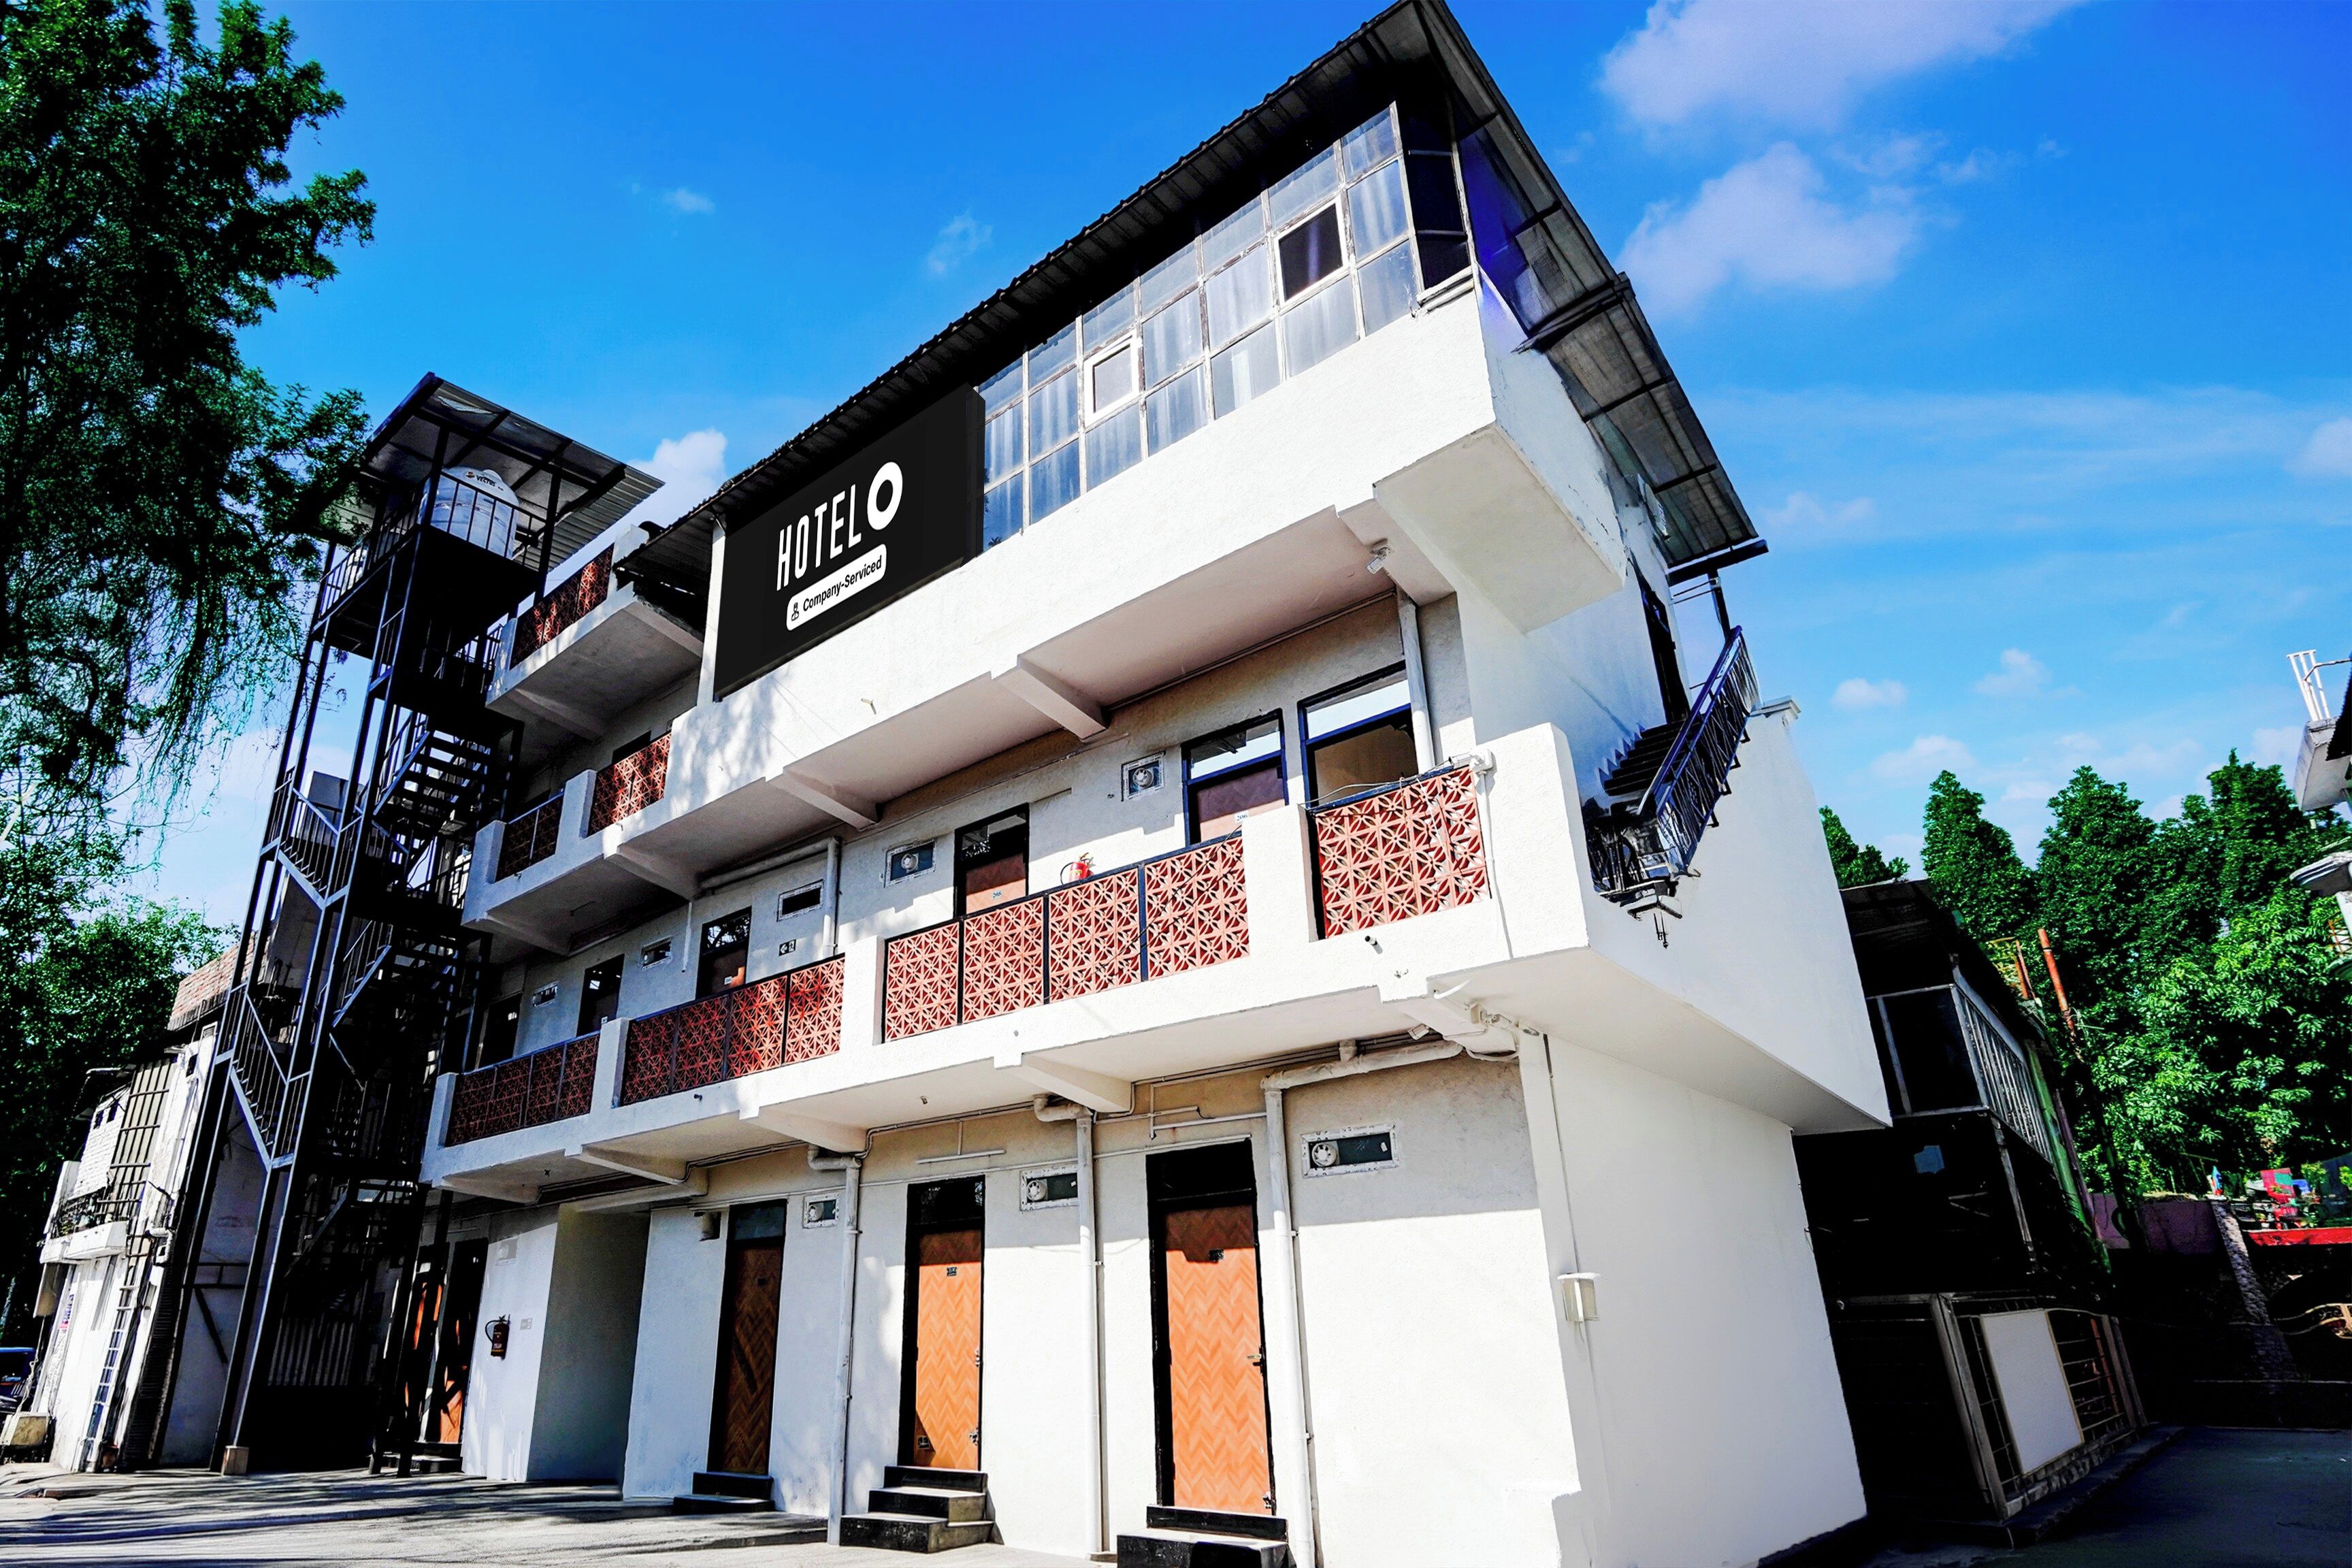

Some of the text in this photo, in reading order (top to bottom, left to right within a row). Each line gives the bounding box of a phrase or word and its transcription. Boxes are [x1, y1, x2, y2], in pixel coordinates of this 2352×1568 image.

[476, 475, 496, 487] VECTUS
[777, 461, 903, 591] HOTEL O
[803, 555, 882, 612] Company-Serviced
